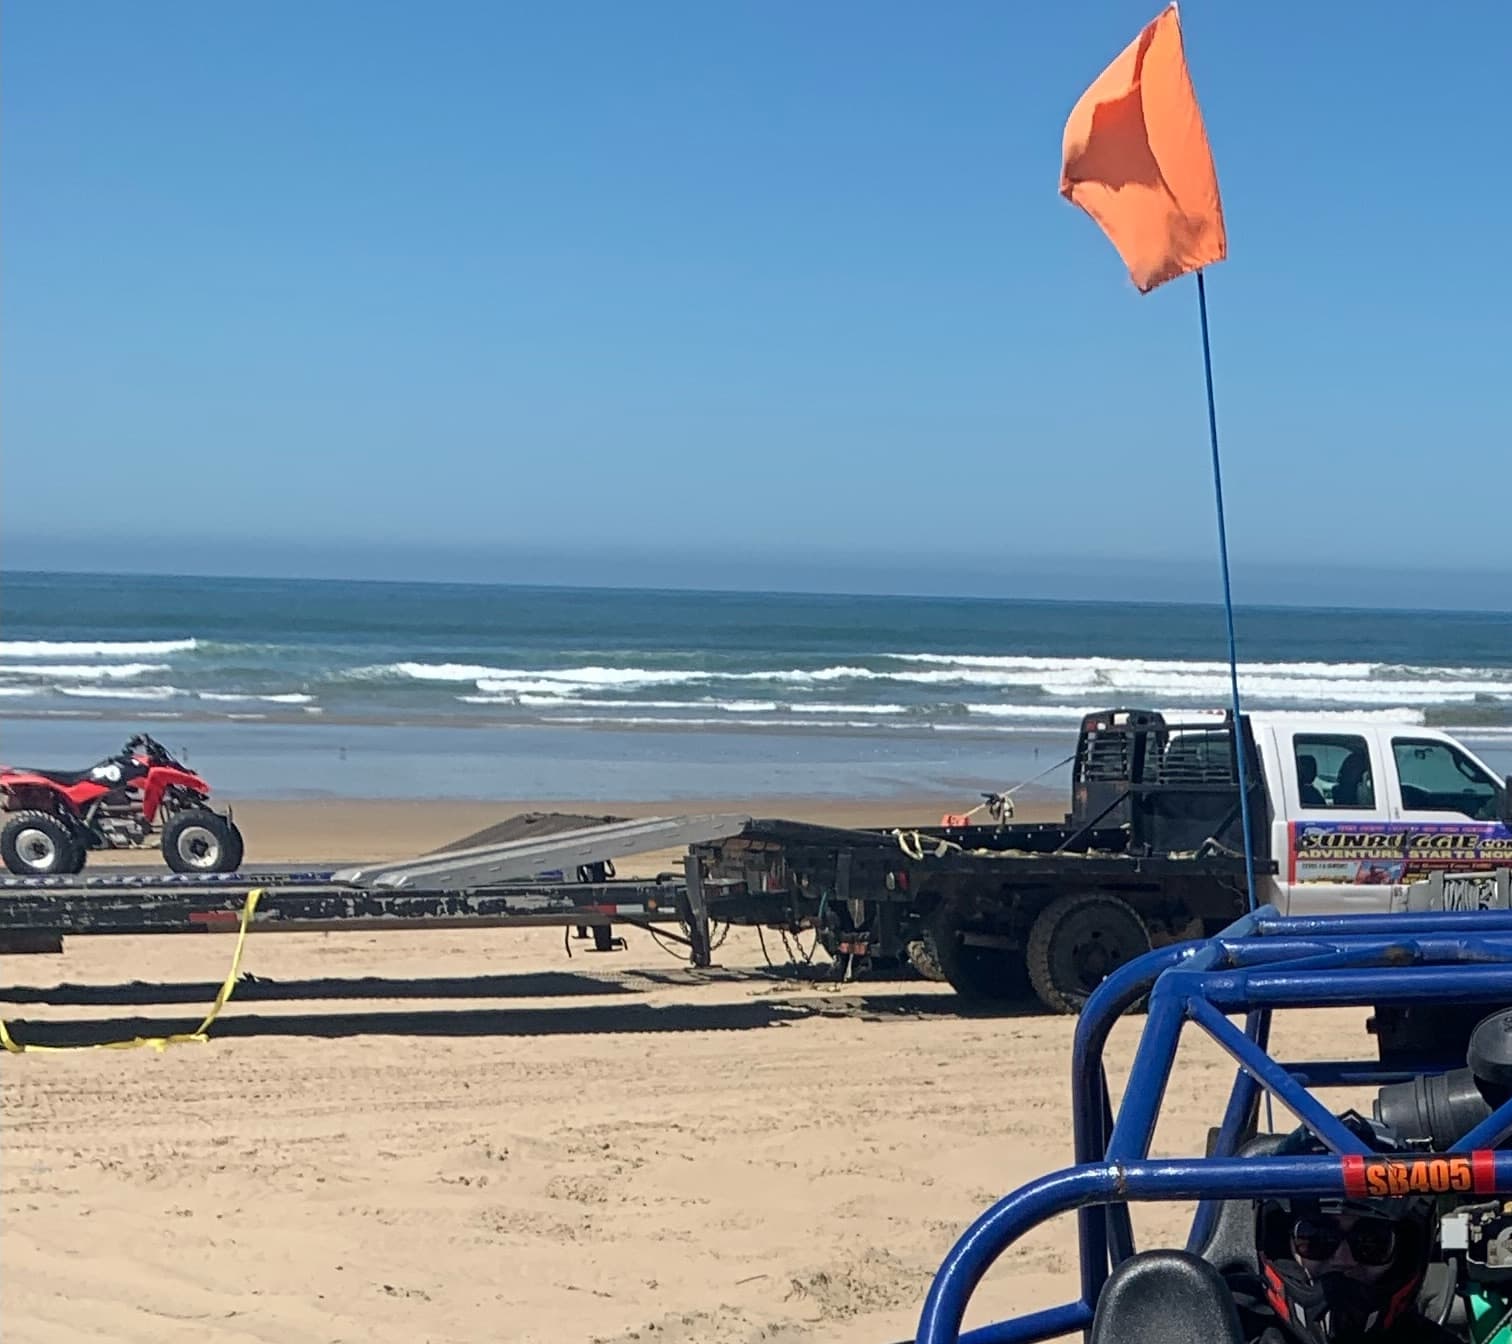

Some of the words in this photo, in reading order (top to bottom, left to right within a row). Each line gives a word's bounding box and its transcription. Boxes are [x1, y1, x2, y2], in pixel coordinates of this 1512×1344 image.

[1298, 849, 1404, 859] ADVENTURE
[1408, 850, 1475, 859] STARTS
[1366, 1158, 1472, 1196] SB405
